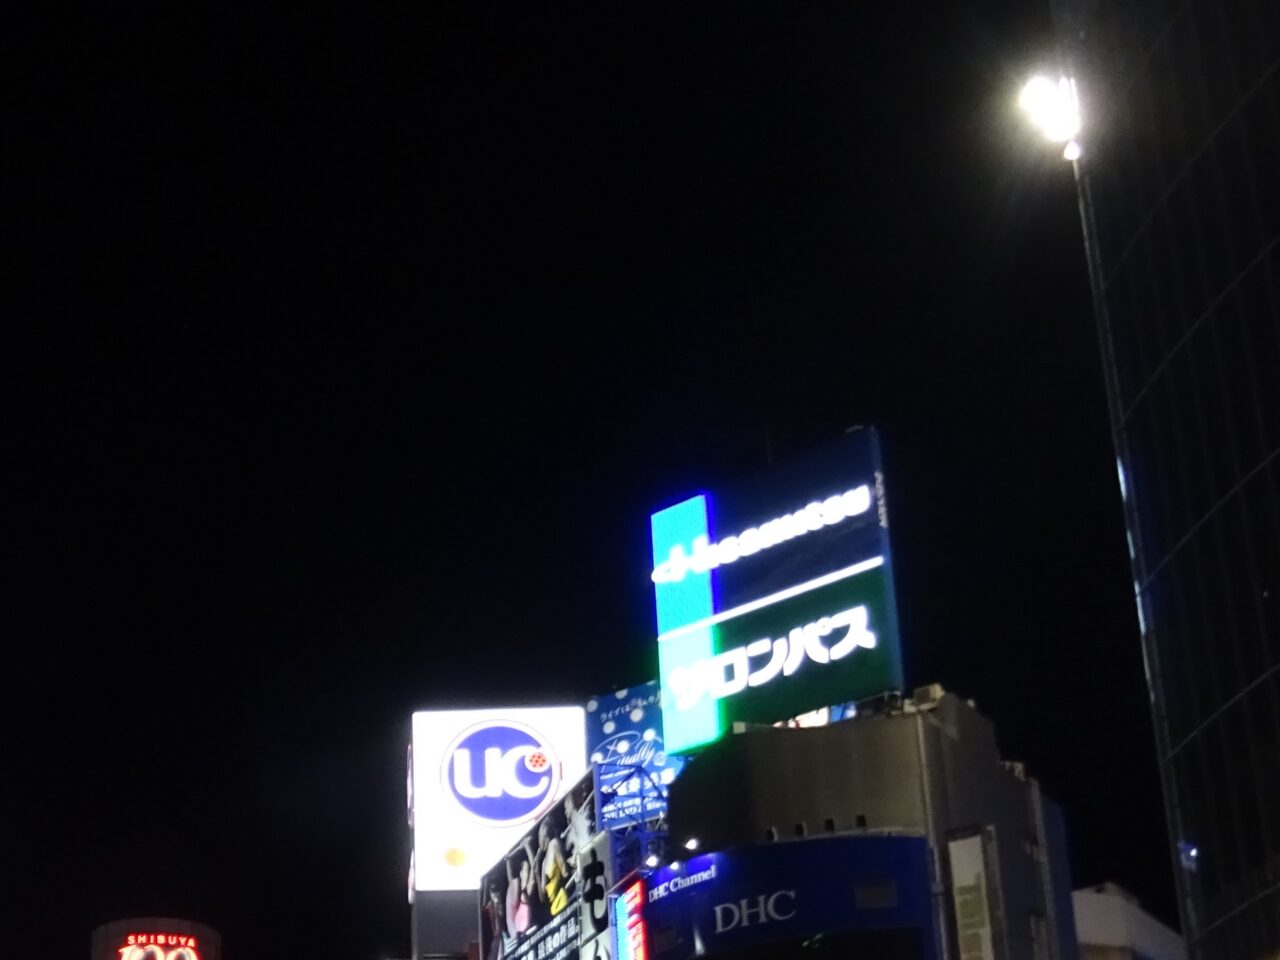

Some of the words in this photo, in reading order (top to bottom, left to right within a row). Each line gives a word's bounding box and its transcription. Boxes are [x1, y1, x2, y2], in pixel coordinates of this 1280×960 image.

[648, 882, 669, 903] DHC
[669, 864, 718, 893] Channel
[713, 890, 796, 934] DHC
[127, 934, 195, 947] SHIBUYA
